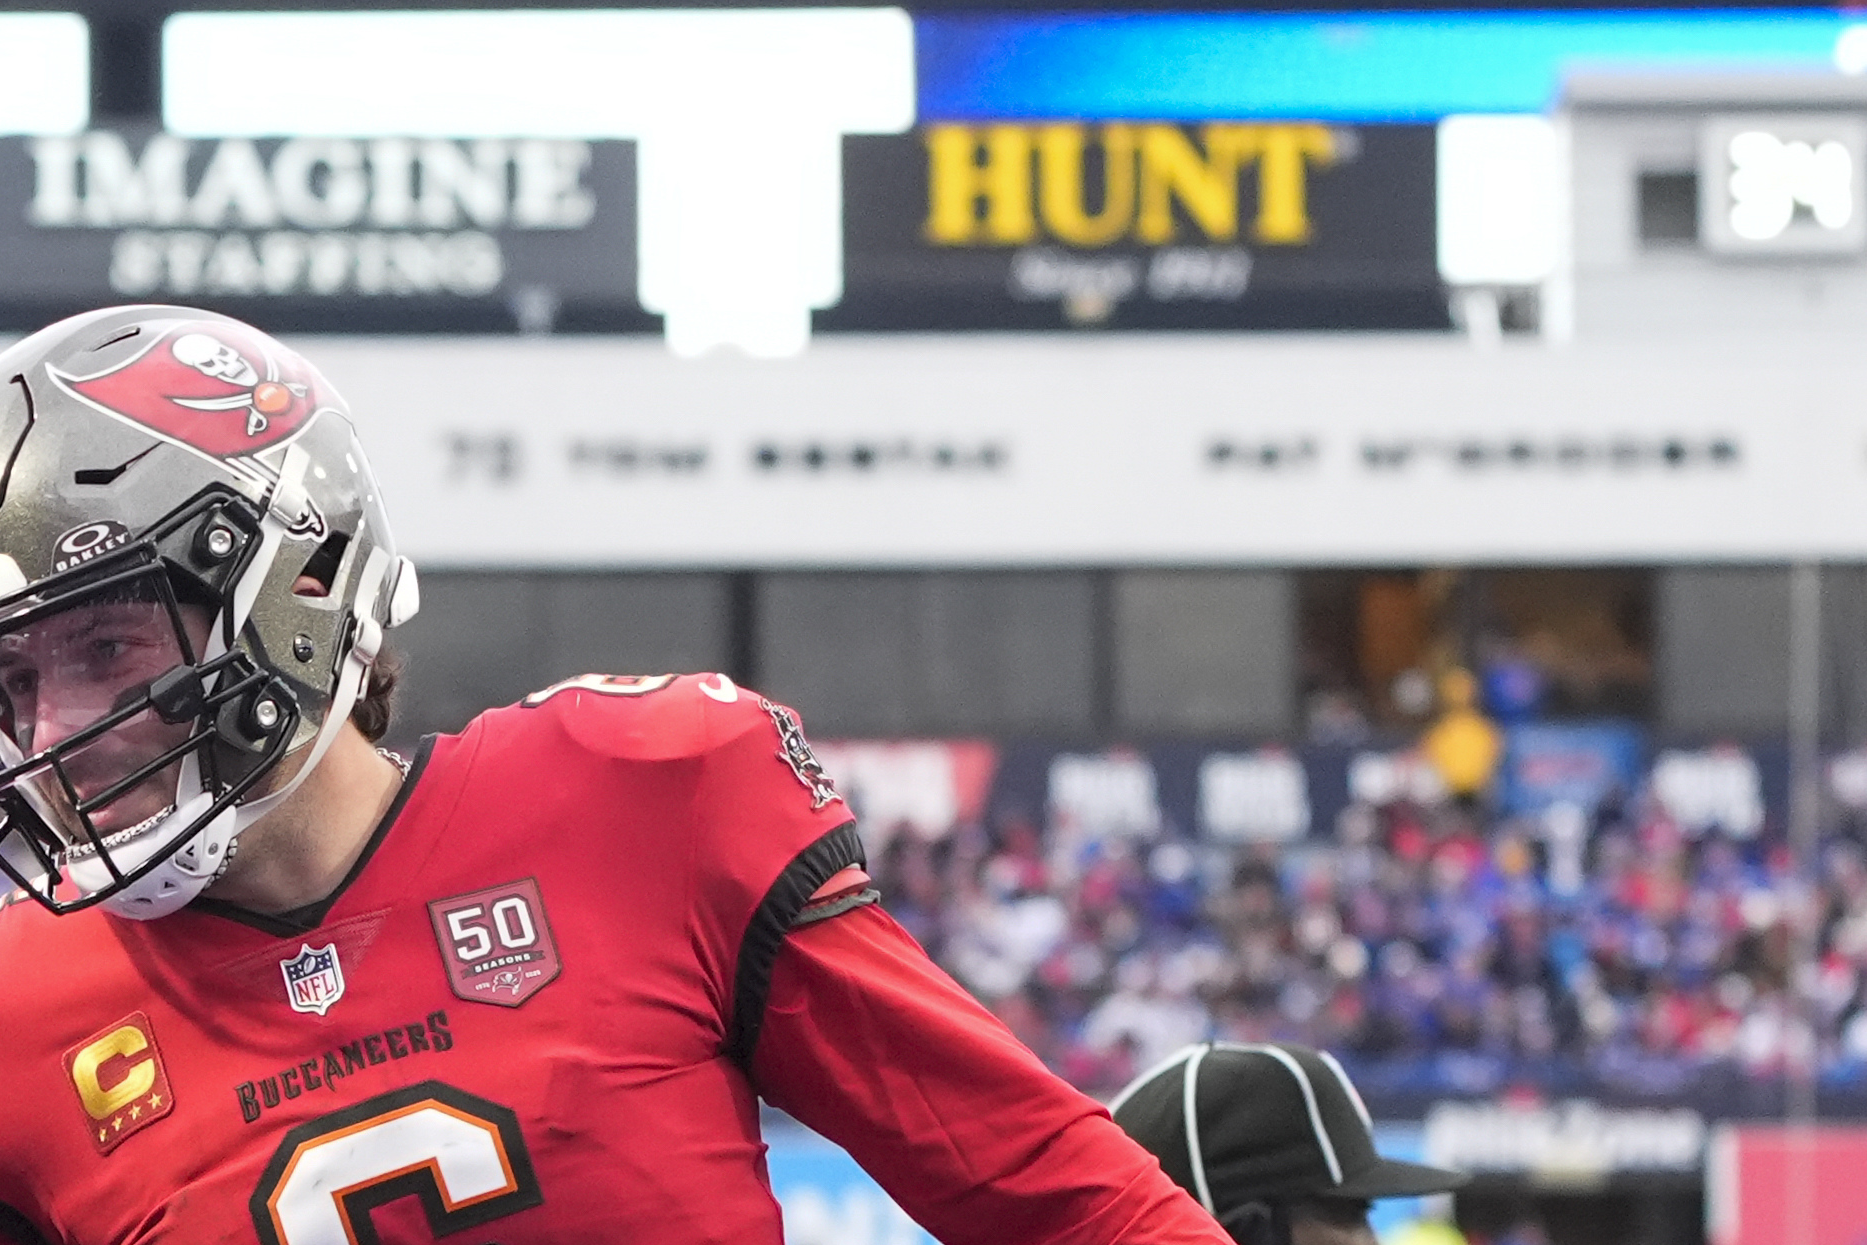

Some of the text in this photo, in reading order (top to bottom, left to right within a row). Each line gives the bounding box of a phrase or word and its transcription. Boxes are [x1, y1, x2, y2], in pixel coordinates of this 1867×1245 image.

[29, 136, 597, 228] IMAGINE
[925, 120, 1339, 248] HUNT
[108, 230, 504, 296] STAFFING
[55, 532, 129, 573] OAKLEY
[446, 896, 537, 961] 50
[296, 973, 336, 1003] NFL
[475, 953, 531, 973] SEASONS
[71, 1024, 156, 1121] C
[235, 1009, 455, 1123] BUCCANEERS
